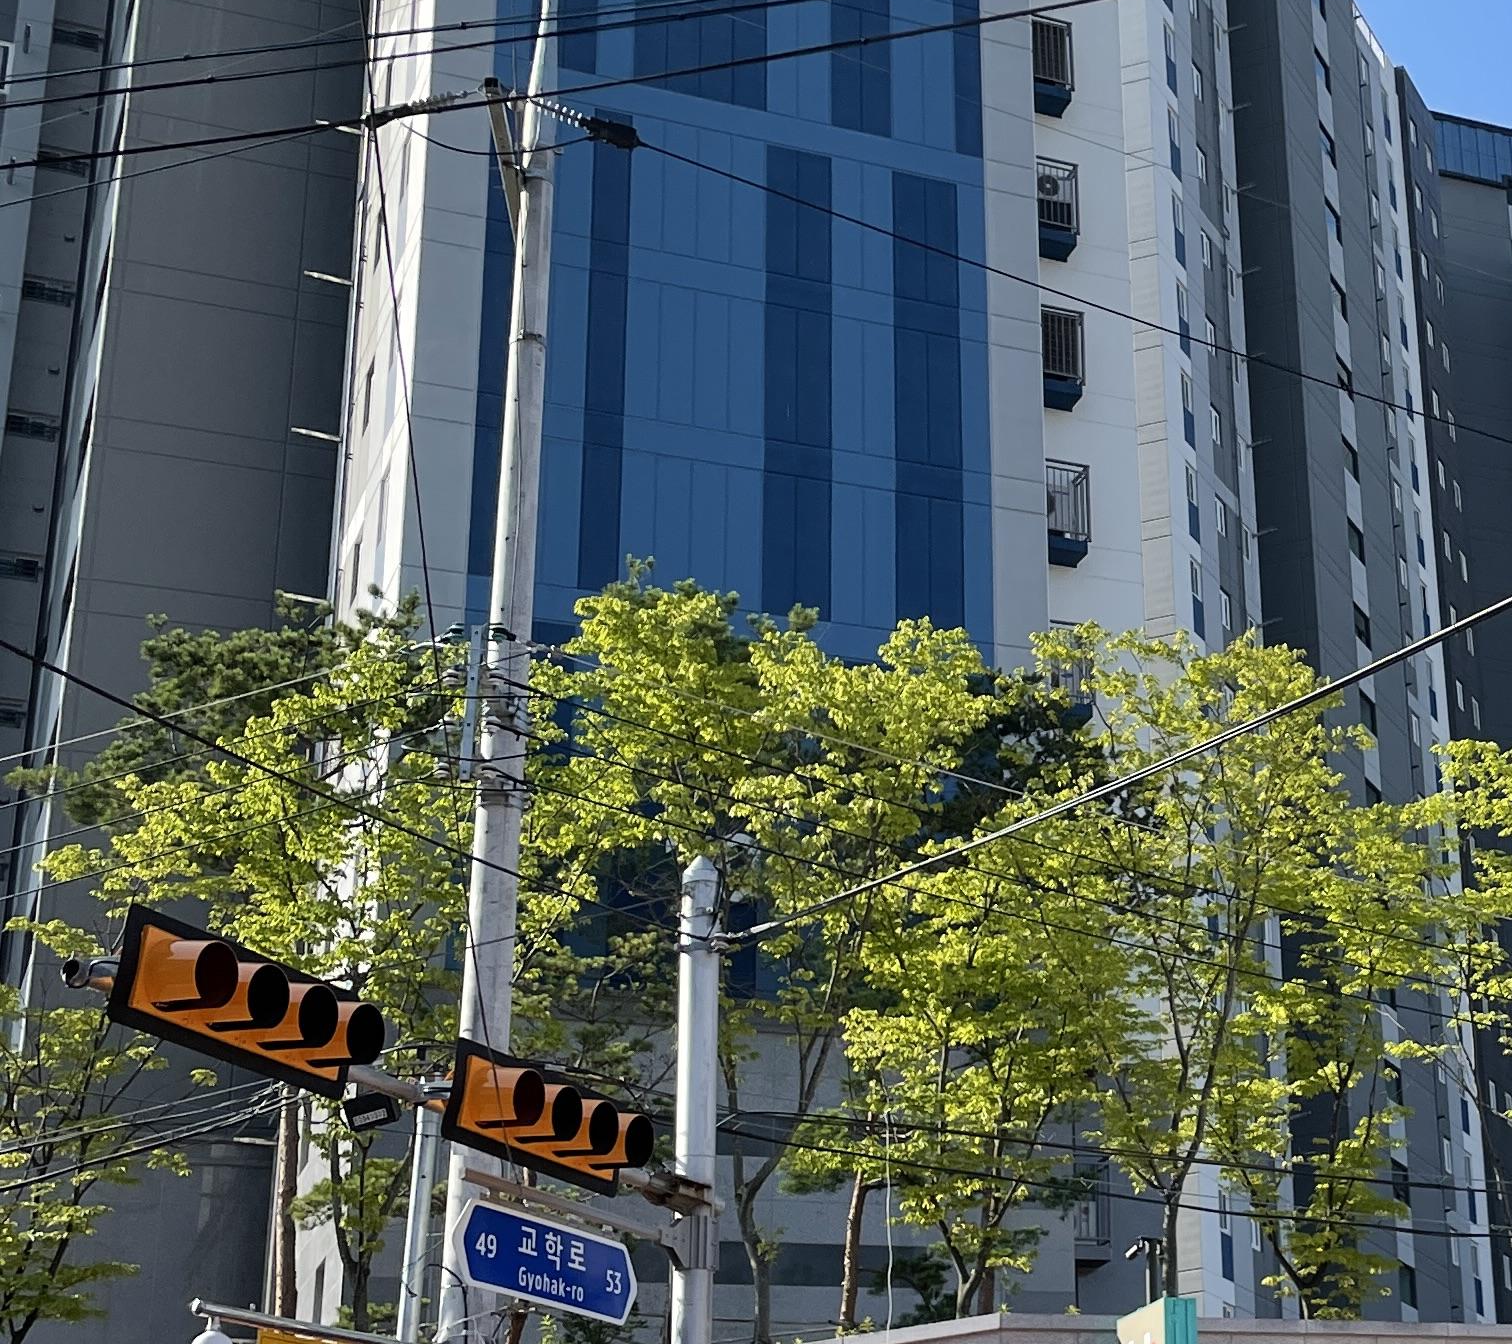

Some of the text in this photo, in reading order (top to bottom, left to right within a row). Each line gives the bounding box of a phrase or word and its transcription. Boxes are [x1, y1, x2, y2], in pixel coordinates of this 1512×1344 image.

[475, 1232, 497, 1258] 49
[518, 1226, 586, 1271] 교학로
[518, 1266, 584, 1302] Gyohak-ro
[605, 1269, 622, 1294] 53
